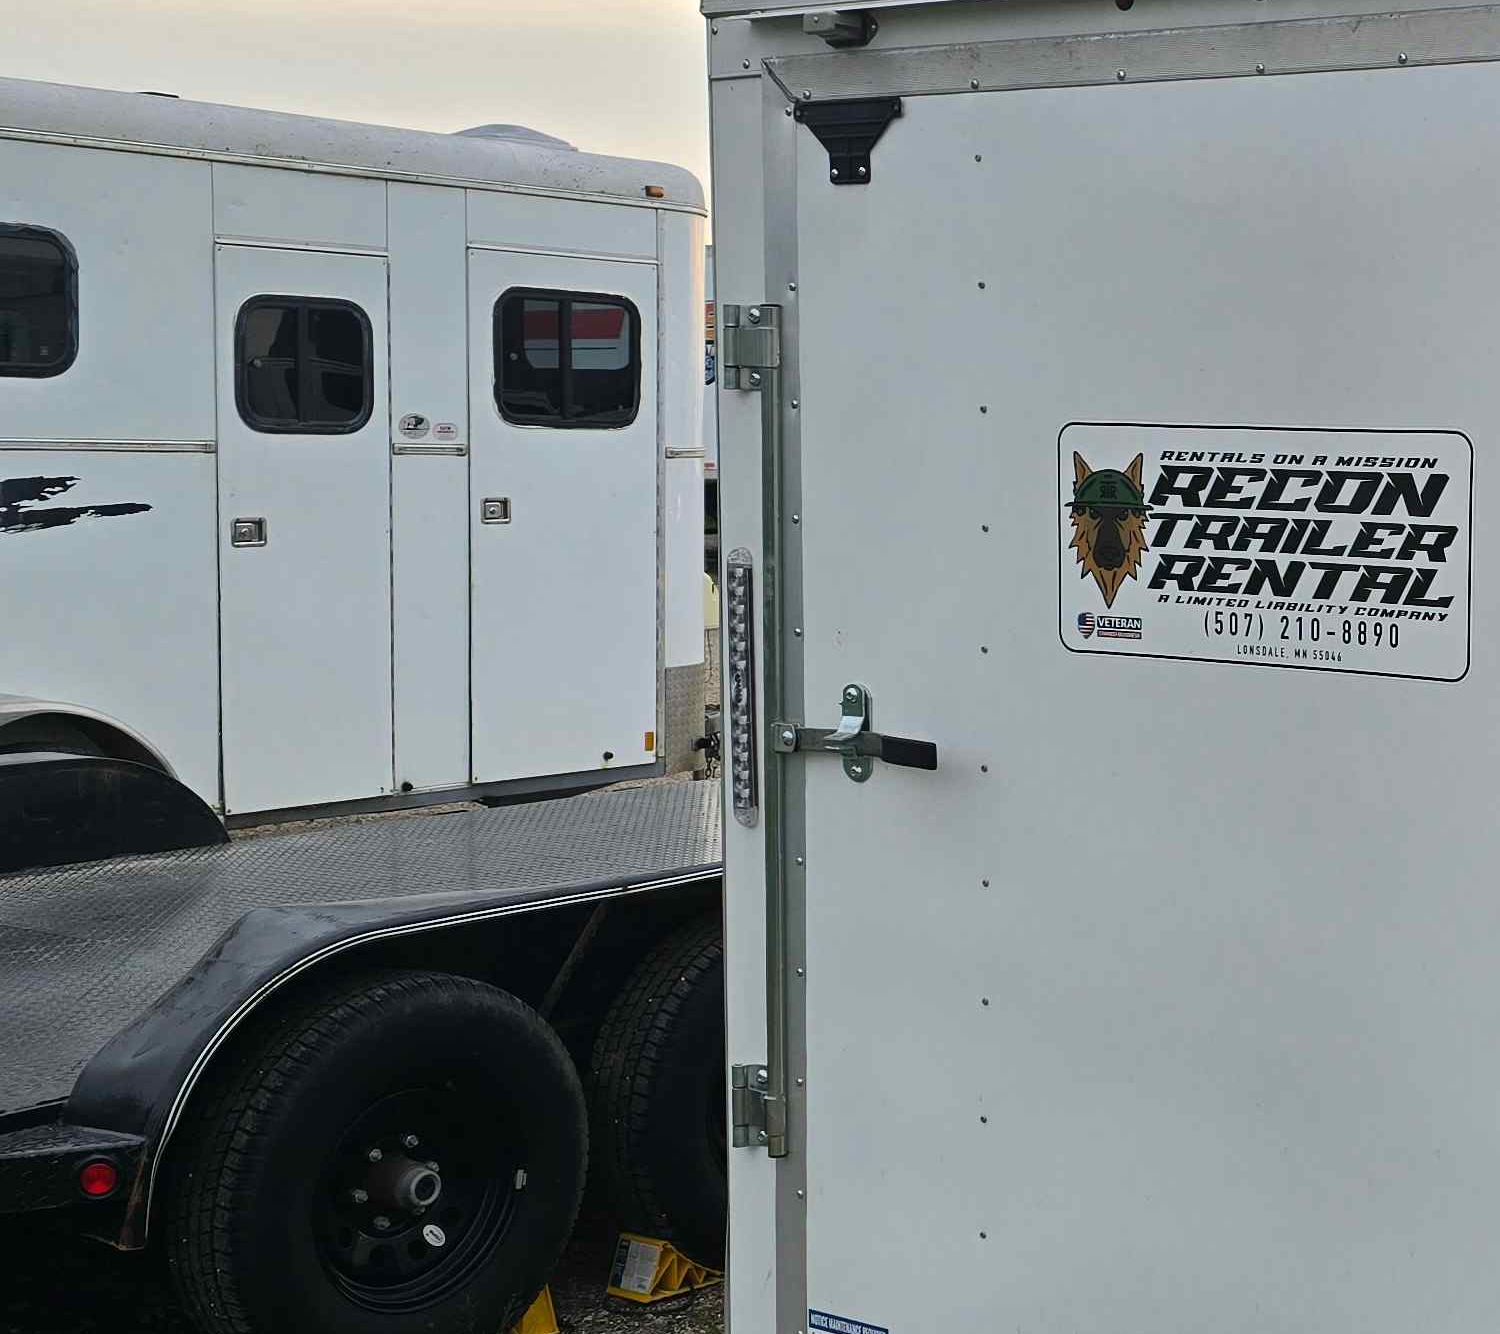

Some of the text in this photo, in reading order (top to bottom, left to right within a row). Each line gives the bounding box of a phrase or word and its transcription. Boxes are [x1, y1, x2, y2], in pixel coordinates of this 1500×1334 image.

[1160, 450, 1439, 469] RENTALS ON A MISSION
[1148, 465, 1450, 518] RECON
[1149, 513, 1459, 563] TRAILER
[1147, 553, 1455, 609] RENTAL
[1098, 617, 1141, 629] VETERAN
[1157, 594, 1449, 622] A LIMITED LIABILITY COMPANY
[1204, 610, 1399, 649] (507) 210-8890
[1237, 644, 1342, 662] LONSDALE, MN 55046
